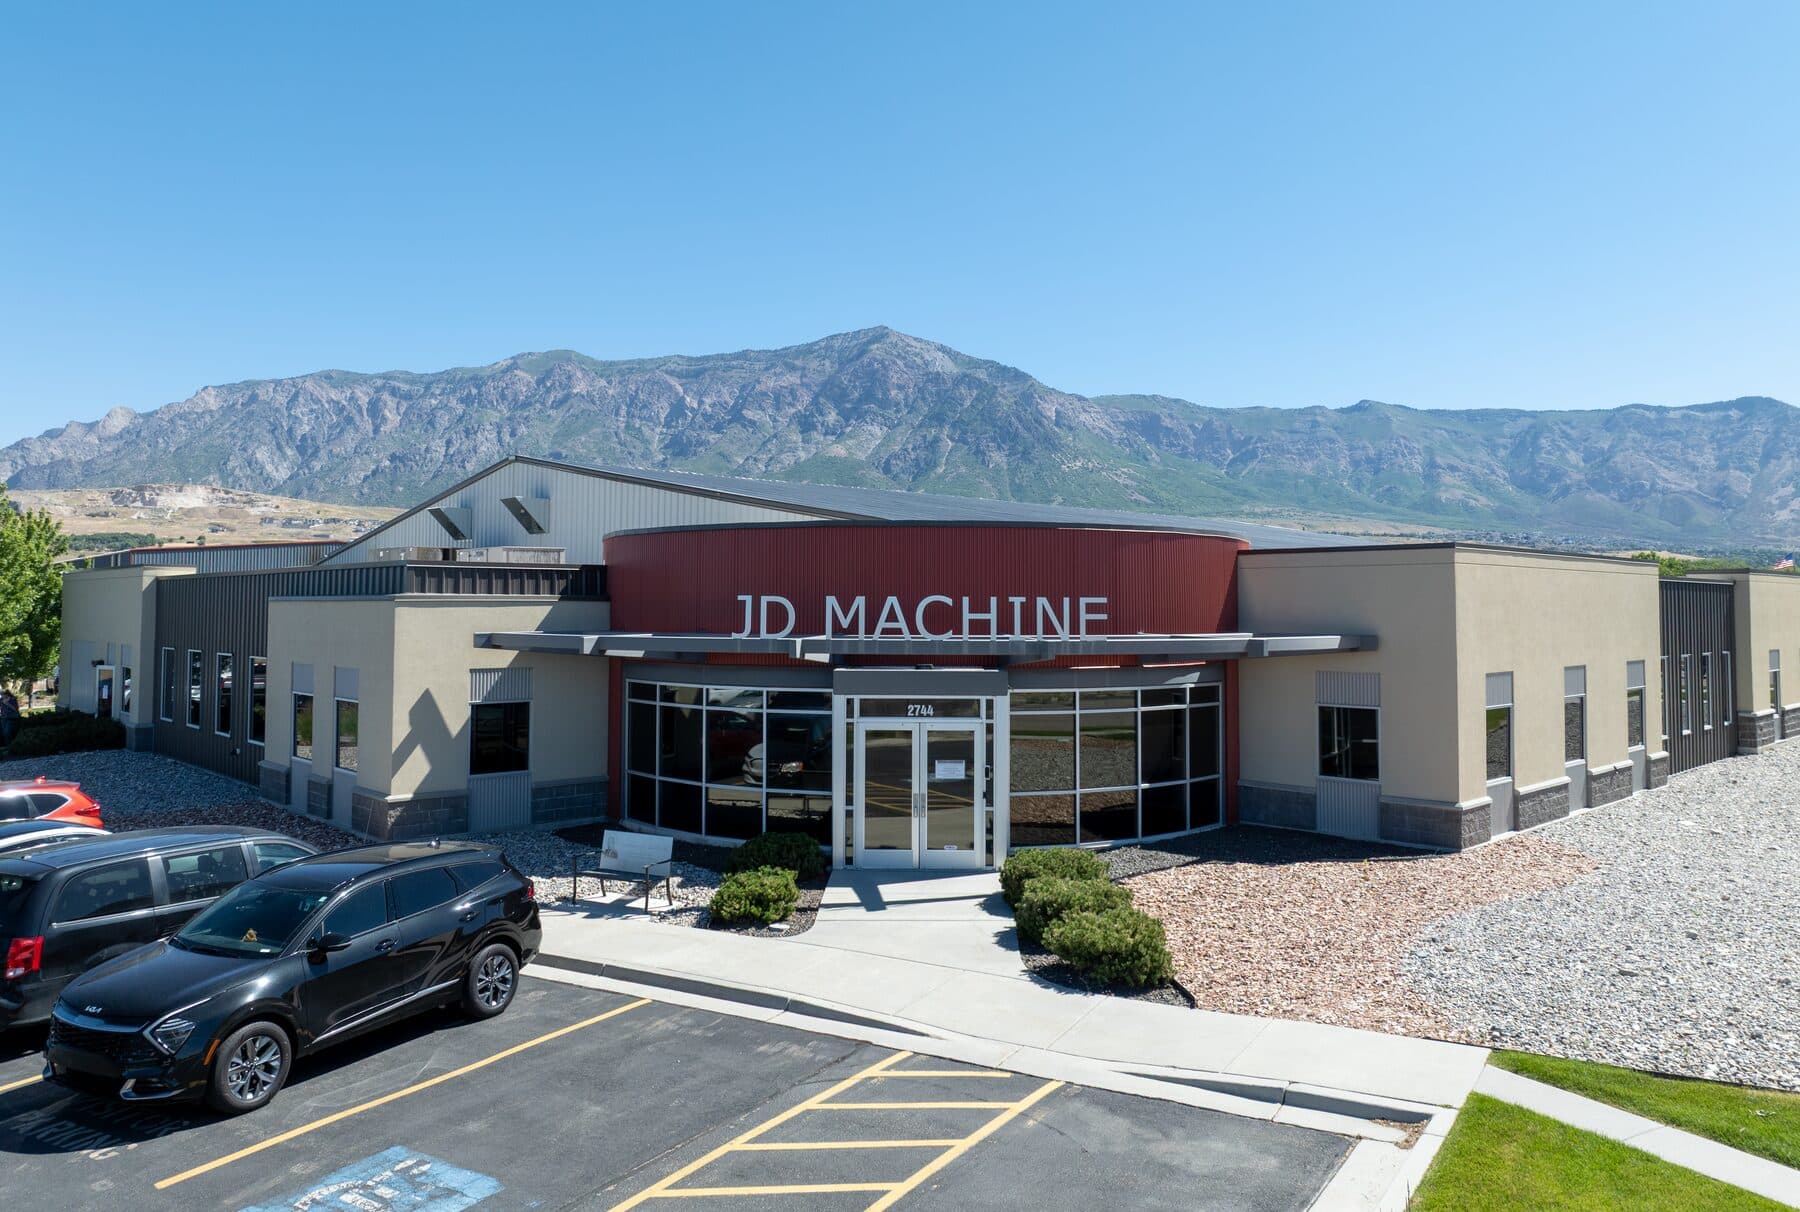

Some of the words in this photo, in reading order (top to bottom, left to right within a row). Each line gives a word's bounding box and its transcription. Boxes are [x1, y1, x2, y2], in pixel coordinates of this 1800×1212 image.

[732, 594, 796, 640] JD
[825, 594, 1108, 642] MACHINE
[907, 704, 934, 717] 2744
[2, 1109, 138, 1161] PARKING
